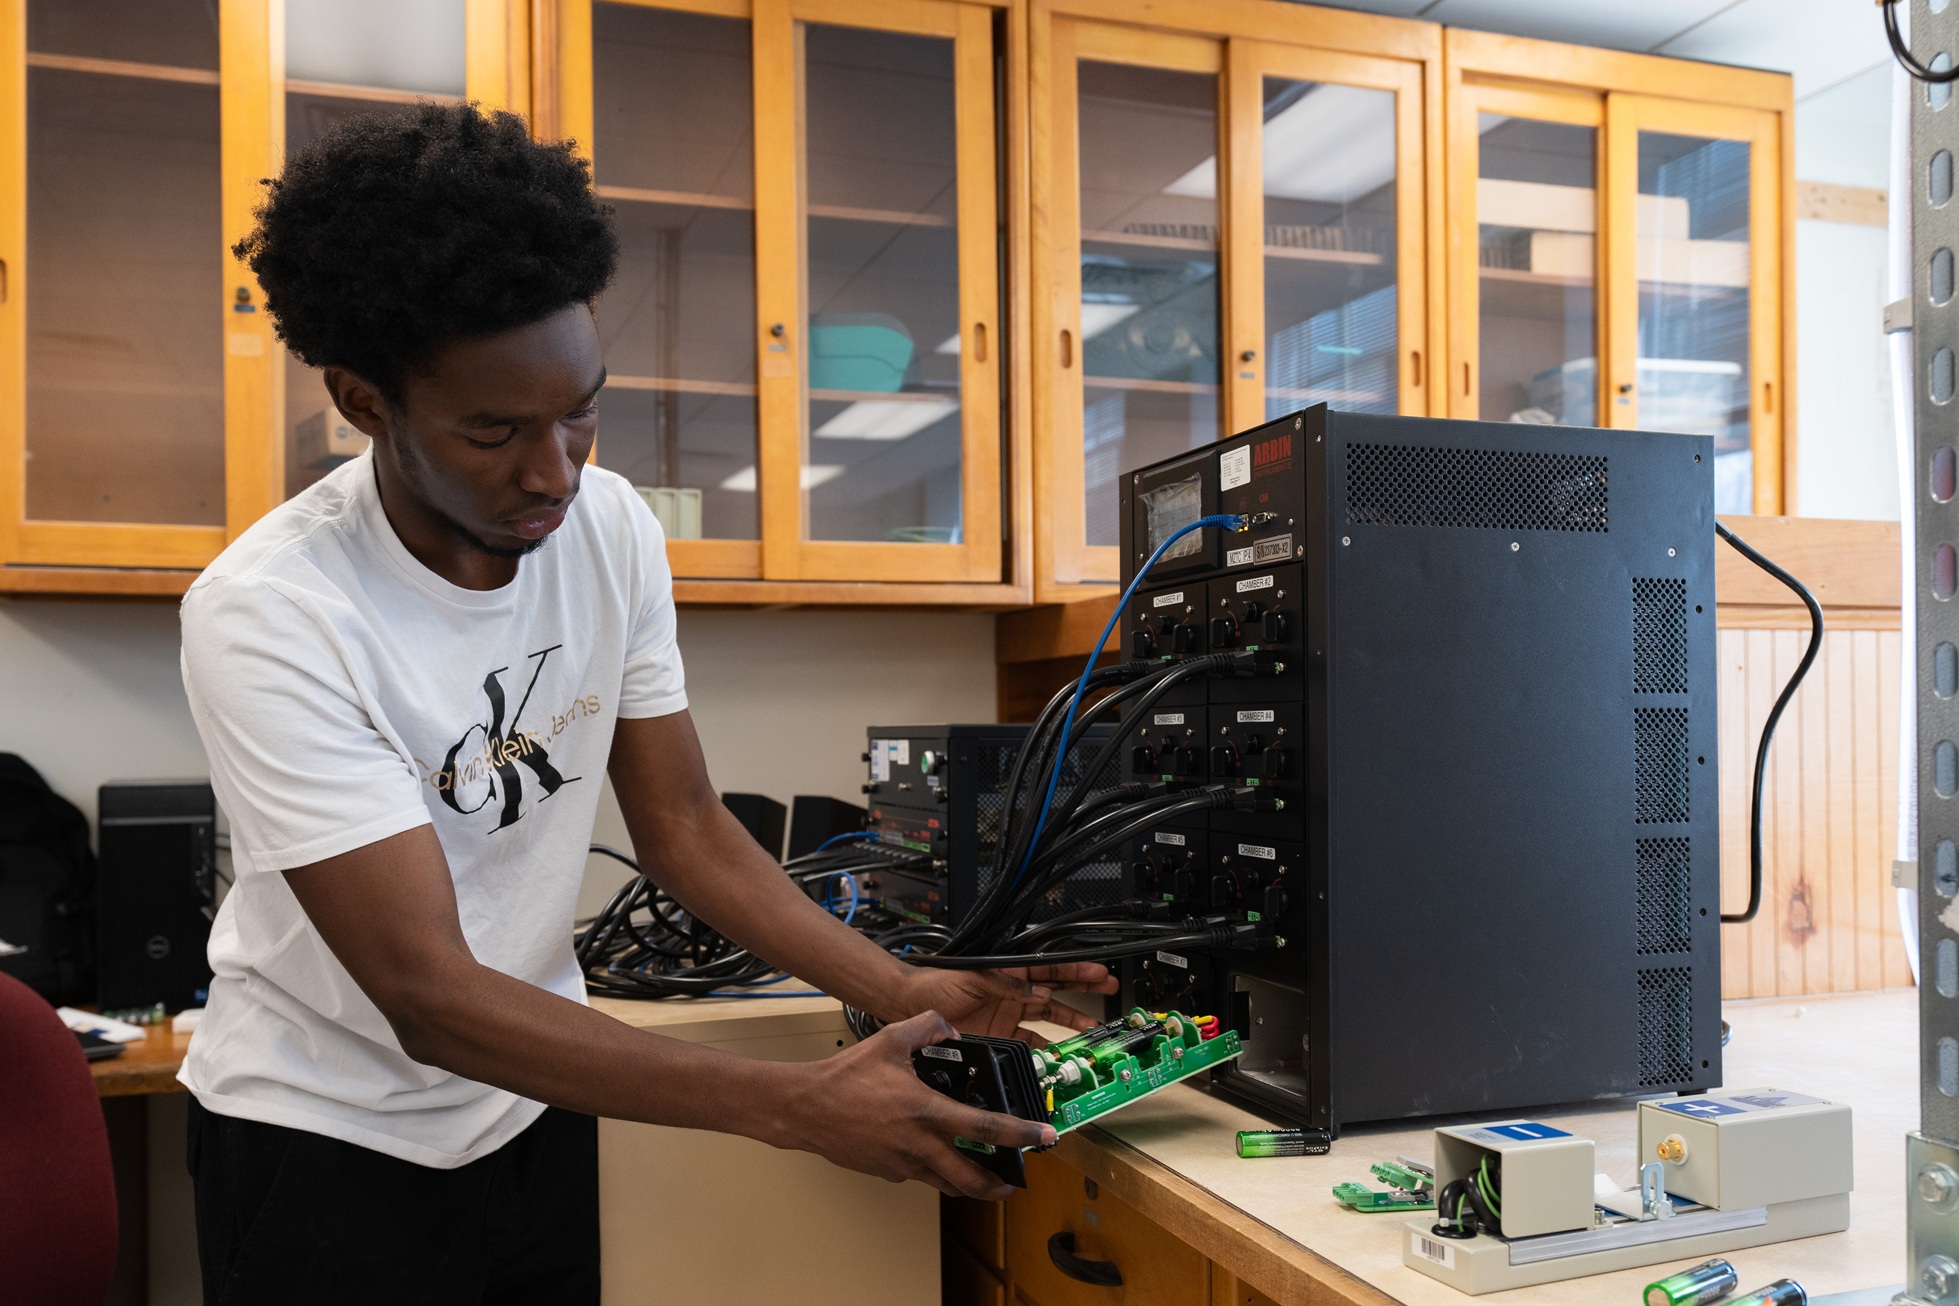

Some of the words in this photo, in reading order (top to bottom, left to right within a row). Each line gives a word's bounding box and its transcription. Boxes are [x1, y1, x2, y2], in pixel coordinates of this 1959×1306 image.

[1254, 434, 1291, 466] ARBIN
[1239, 578, 1263, 591] CHAMBER
[1264, 576, 1272, 587] #2
[1155, 594, 1176, 606] CHAMBER
[1176, 593, 1182, 603] #1
[1156, 714, 1176, 724] CHAMBER
[1239, 711, 1264, 721] CHAMBER
[1265, 711, 1272, 721] #4
[1157, 833, 1177, 844] CHAMBER
[1241, 845, 1265, 857] CHAMBER
[1159, 952, 1179, 965] CHAMBER
[1180, 957, 1186, 967] #7
[924, 1046, 950, 1059] CHAMBER
